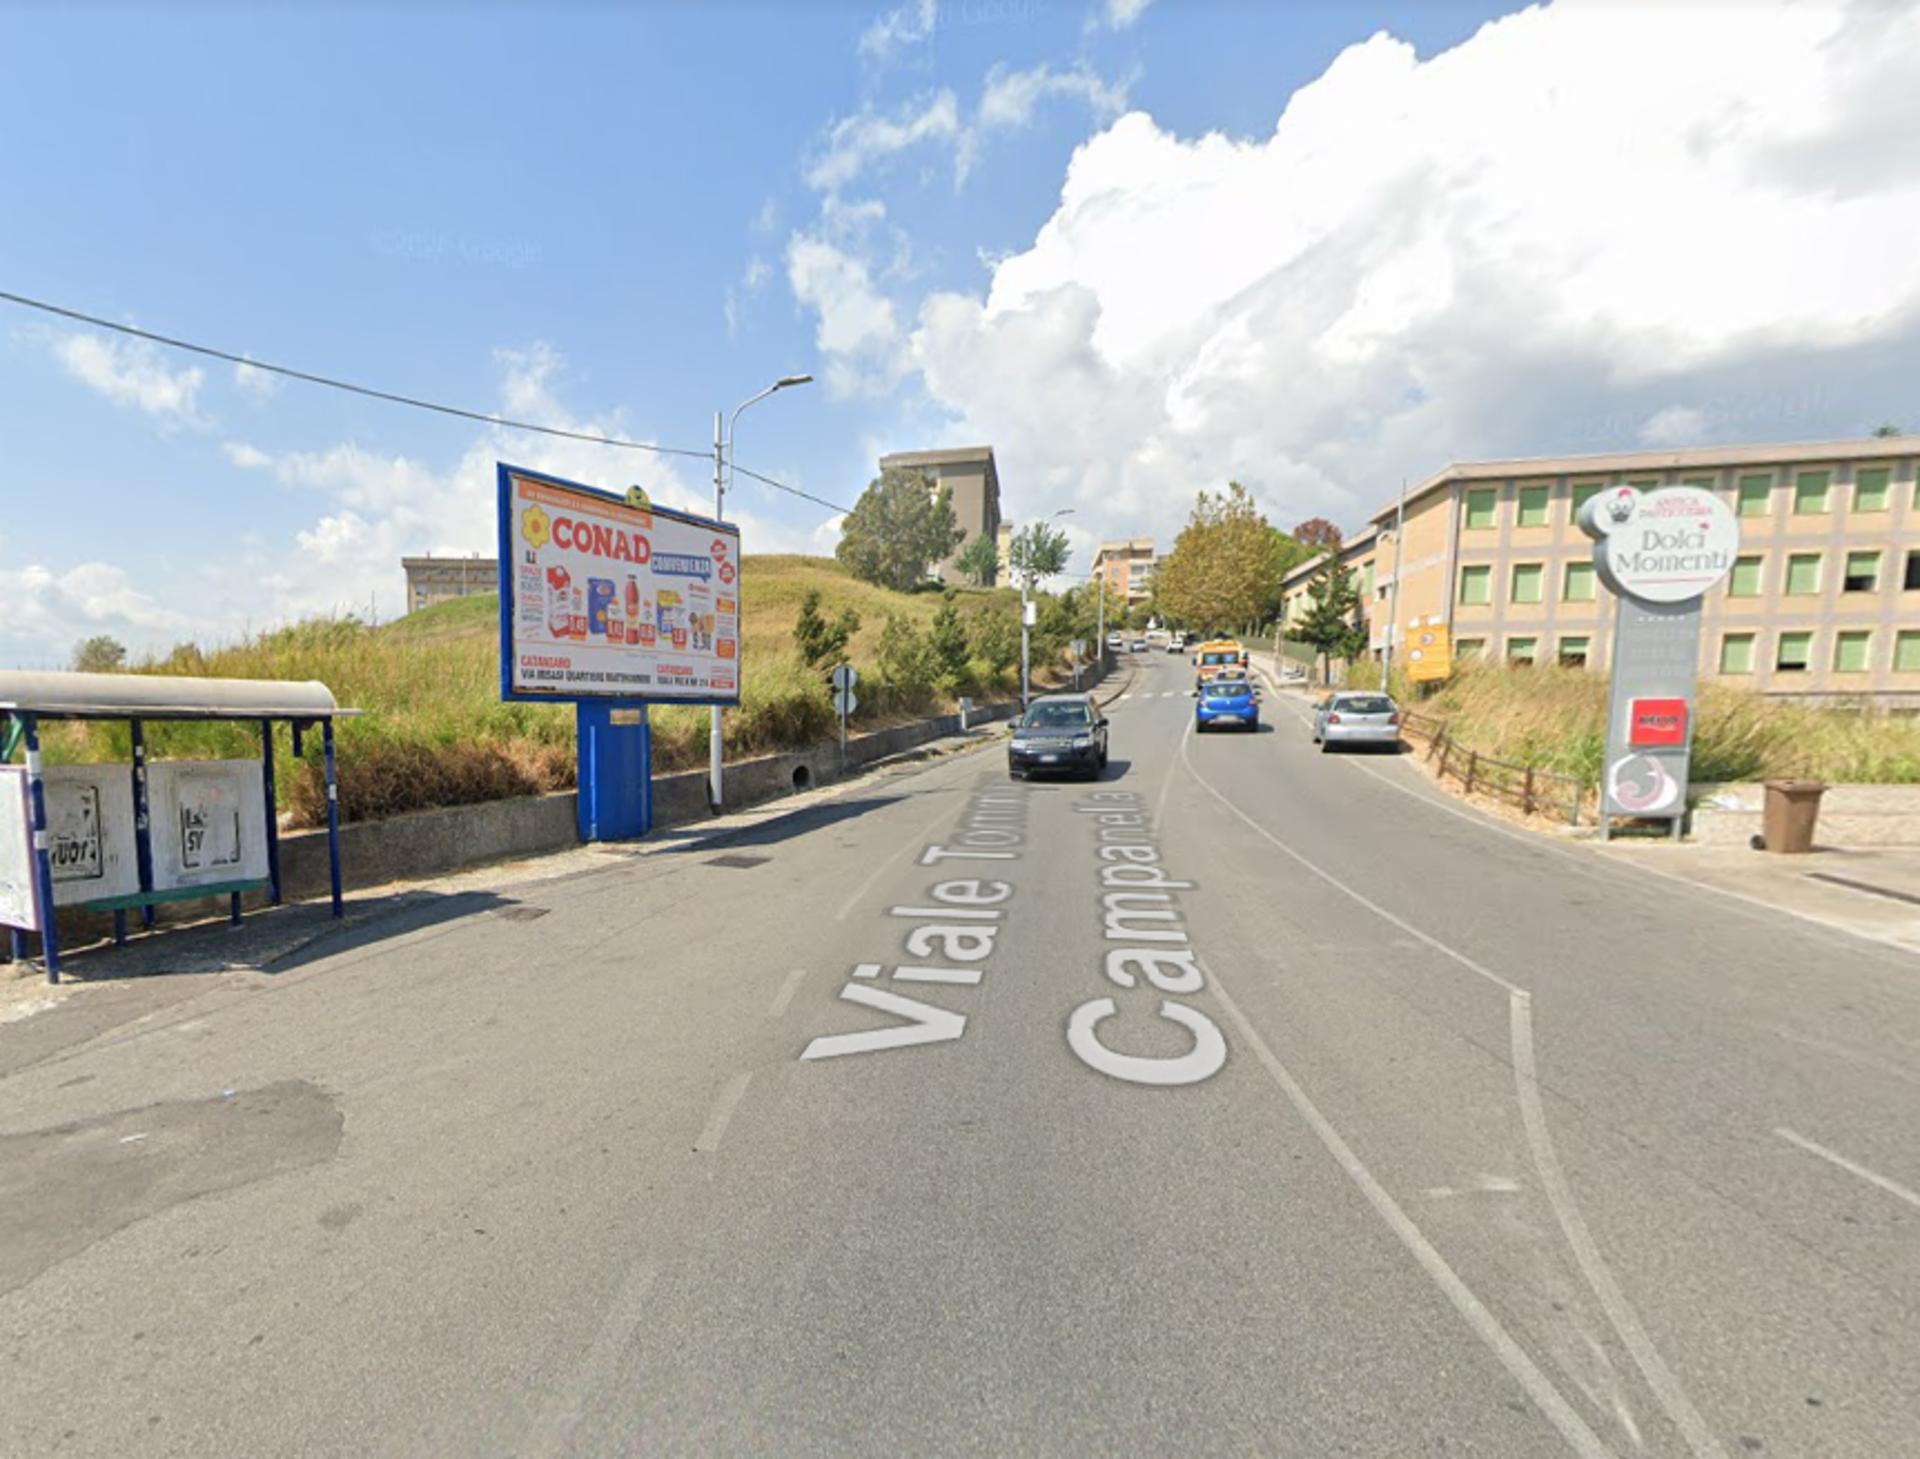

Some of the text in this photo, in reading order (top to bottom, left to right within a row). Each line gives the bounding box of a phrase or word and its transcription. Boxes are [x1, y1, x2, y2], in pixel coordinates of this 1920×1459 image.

[552, 516, 651, 565] CONAD
[1642, 529, 1706, 552] Dolci
[1616, 549, 1729, 573] Momenti
